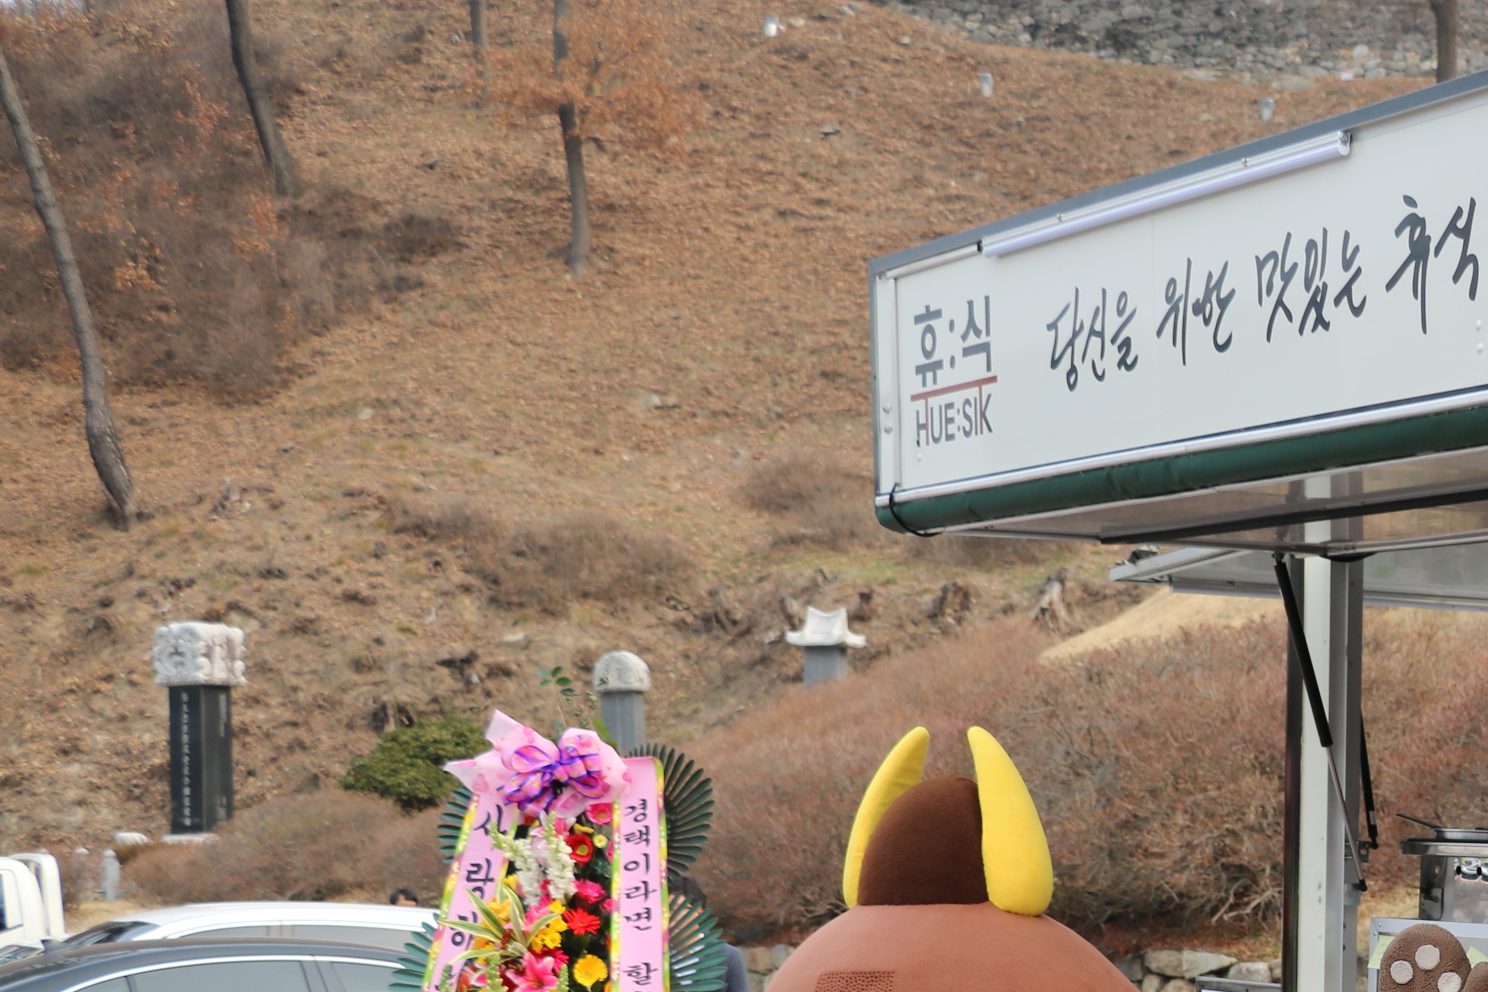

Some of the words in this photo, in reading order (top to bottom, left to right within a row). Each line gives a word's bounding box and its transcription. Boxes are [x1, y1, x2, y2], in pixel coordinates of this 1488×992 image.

[1046, 287, 1139, 392] 당신을
[1155, 257, 1236, 367] 위한
[1254, 226, 1367, 343] 맛있는
[1384, 194, 1480, 335] 휴식
[915, 393, 993, 448] HUE:SIK
